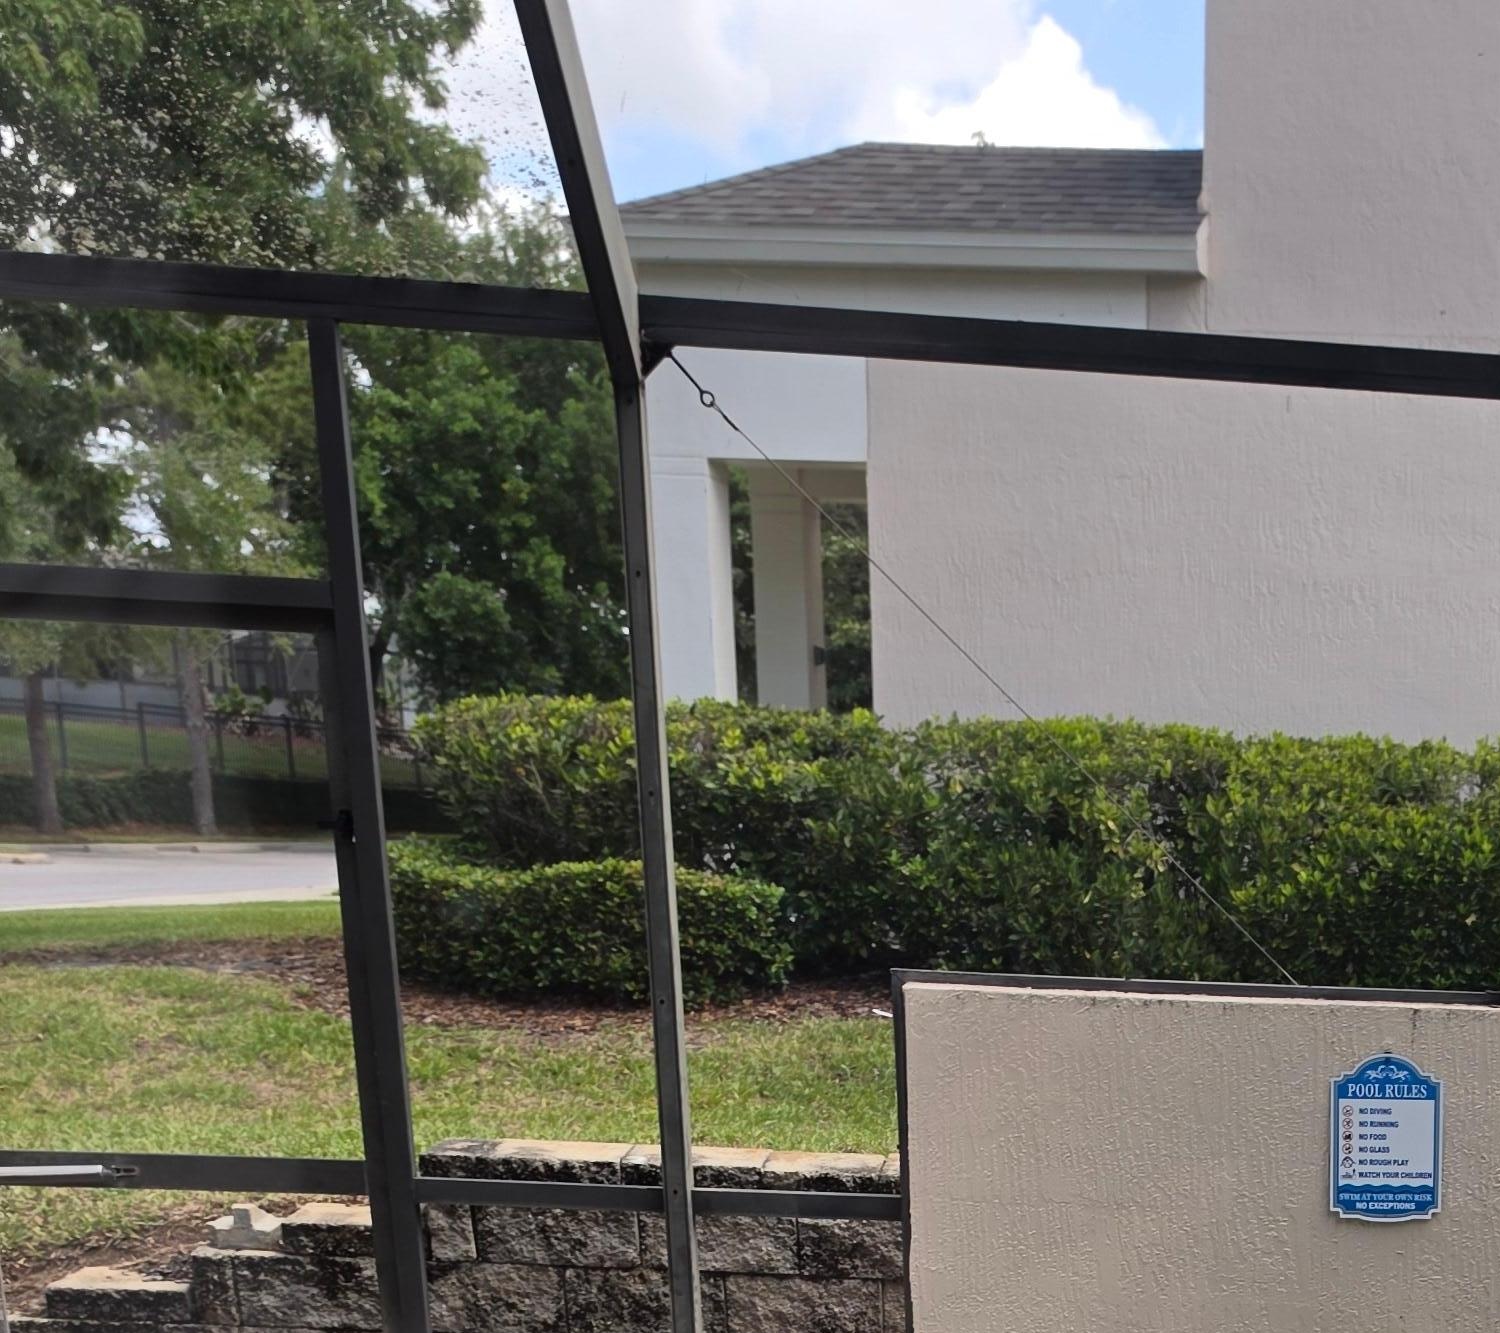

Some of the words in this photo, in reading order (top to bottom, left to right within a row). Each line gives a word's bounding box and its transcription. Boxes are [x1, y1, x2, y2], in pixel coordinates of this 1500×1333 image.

[1347, 1083, 1383, 1098] POOL
[1385, 1084, 1427, 1098] RULES
[1373, 1193, 1394, 1201] YOUR
